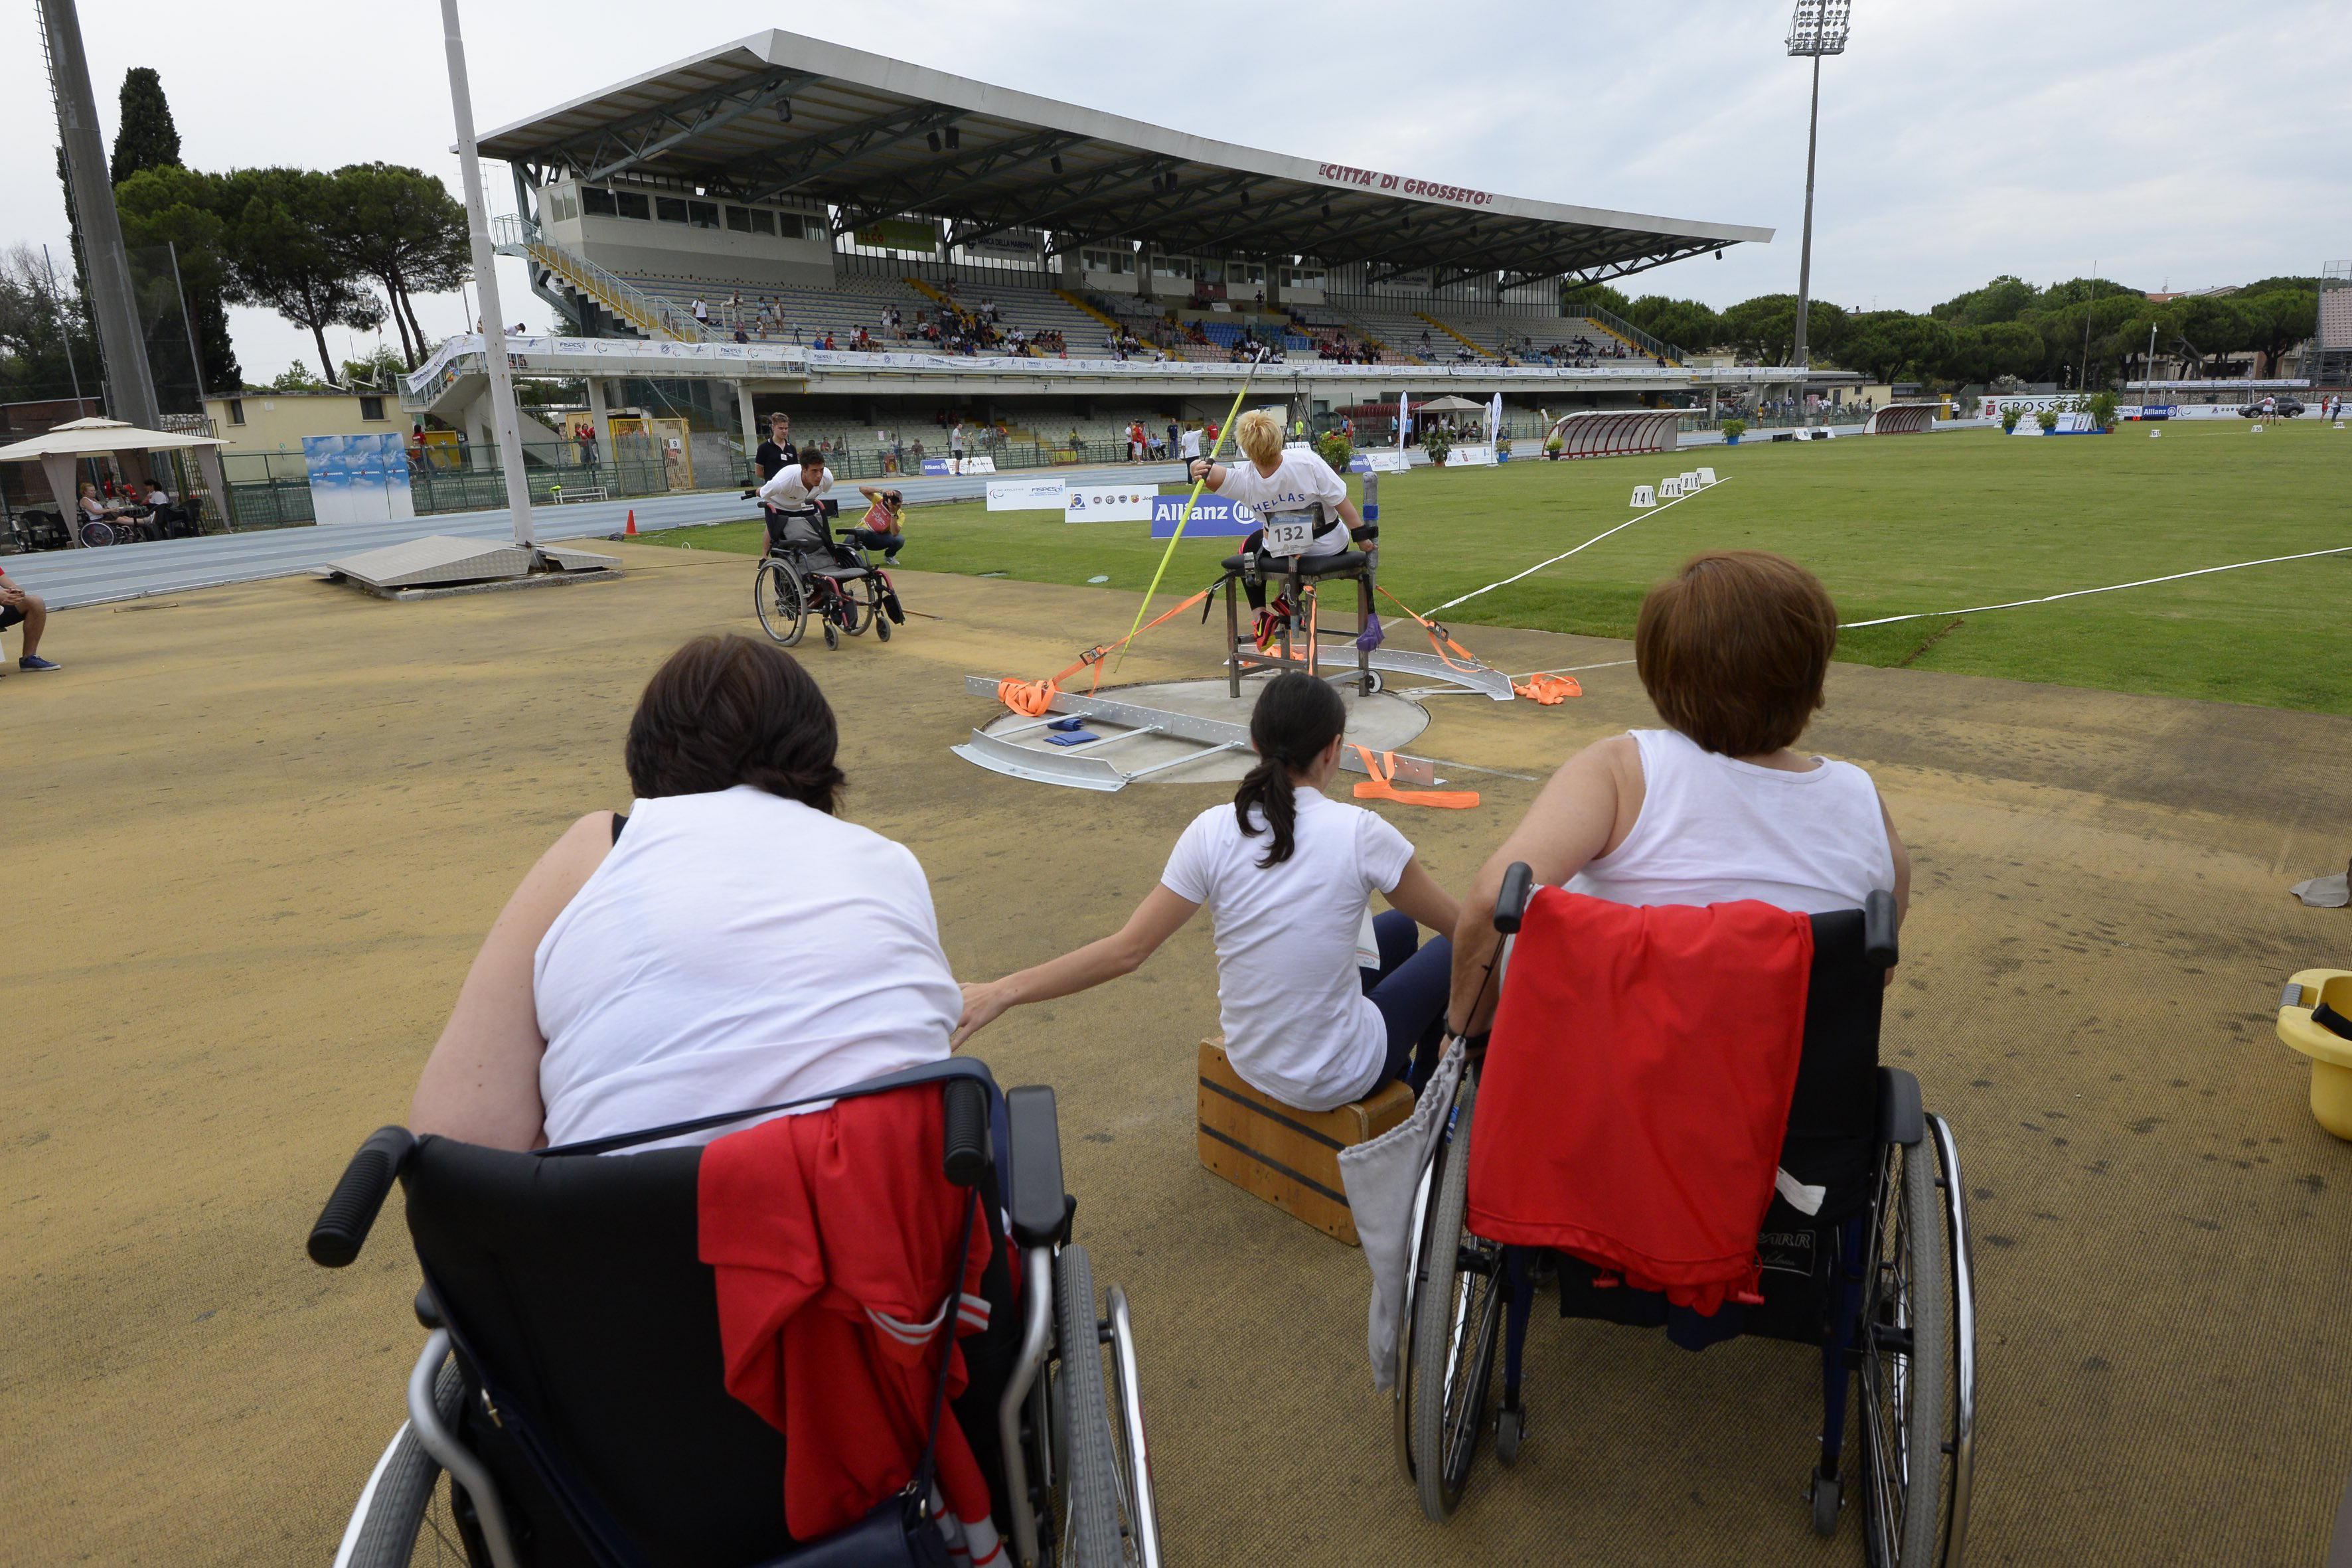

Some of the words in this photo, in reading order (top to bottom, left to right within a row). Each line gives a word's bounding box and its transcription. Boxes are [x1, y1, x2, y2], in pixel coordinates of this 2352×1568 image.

[1326, 164, 1378, 186] CITTA'
[1379, 173, 1400, 190] DI
[1403, 179, 1487, 205] GROSSETO
[1660, 484, 1670, 496] 16
[1671, 483, 1682, 495] 16
[1690, 477, 1699, 488] 18
[1252, 493, 1305, 512] HELLAS
[1634, 492, 1646, 505] 14
[1275, 525, 1304, 542] 132
